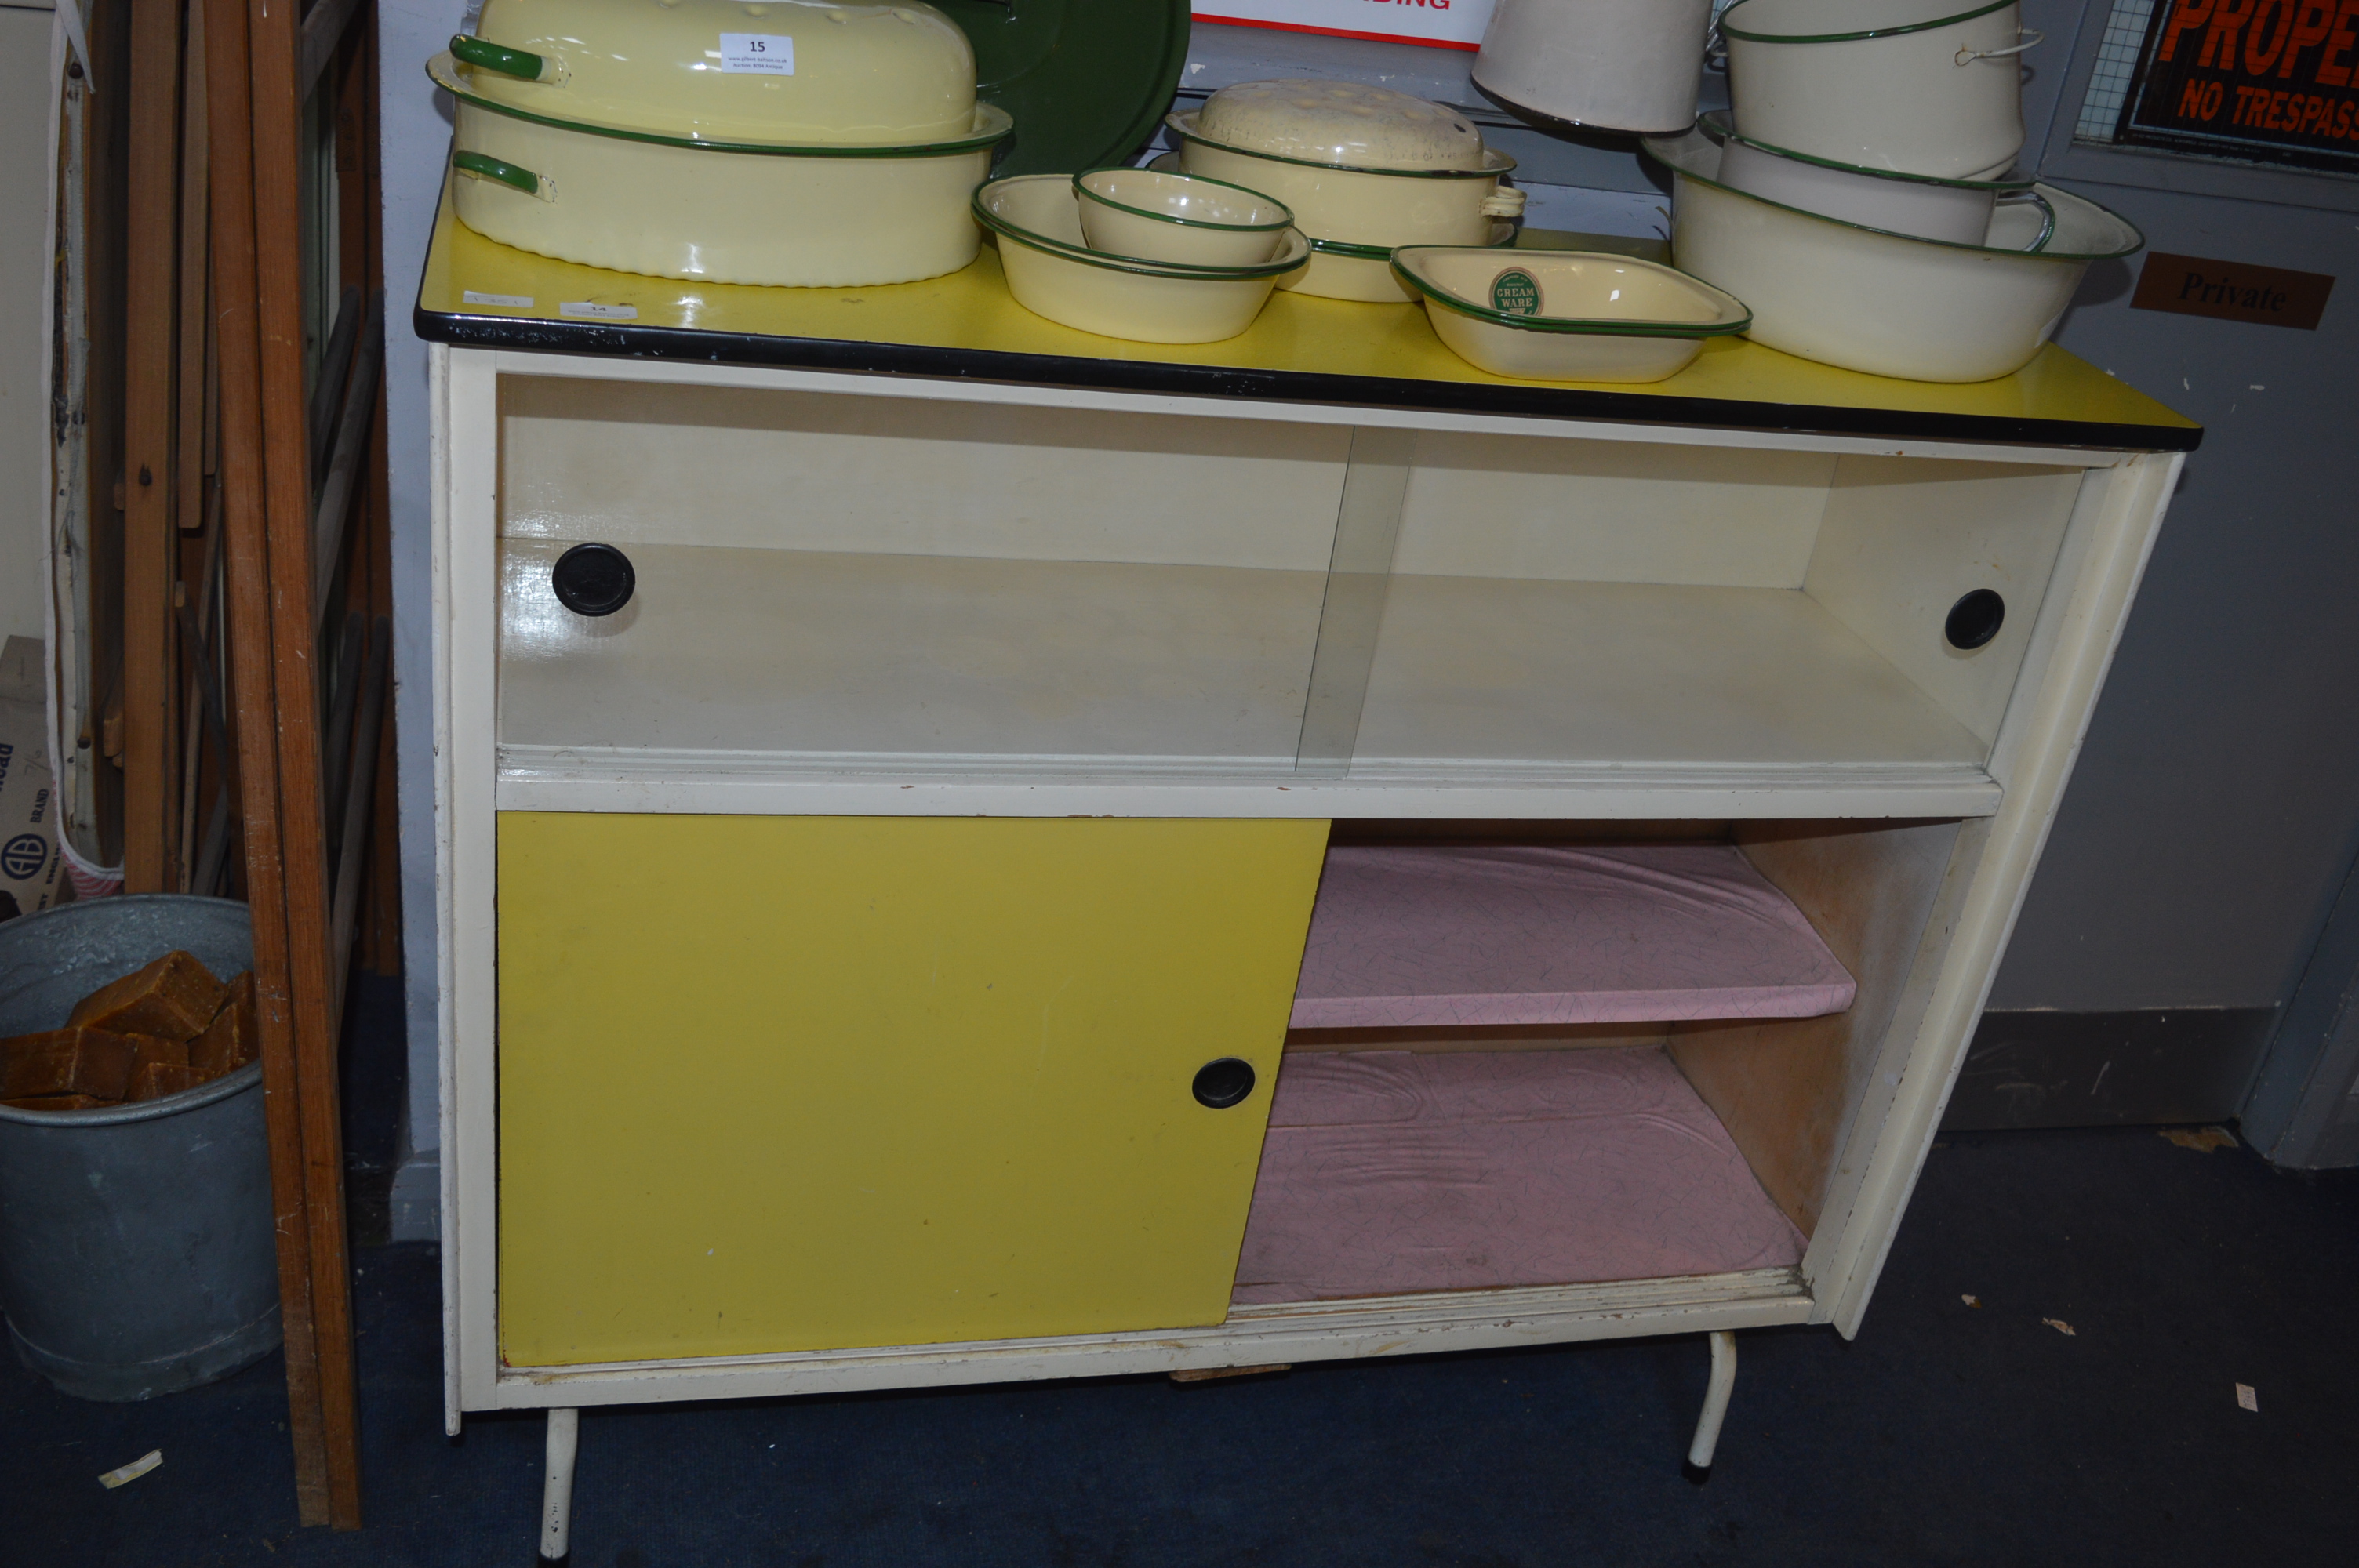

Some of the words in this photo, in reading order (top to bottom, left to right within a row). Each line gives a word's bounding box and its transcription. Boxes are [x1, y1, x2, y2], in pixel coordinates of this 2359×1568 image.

[750, 41, 765, 52] 15
[2158, 0, 2359, 89] PROPE
[2178, 78, 2223, 121] NO
[1497, 288, 1535, 297] CREAM
[1502, 297, 1533, 307] WARE
[2178, 271, 2287, 312] Private
[29, 789, 49, 823] BRAND
